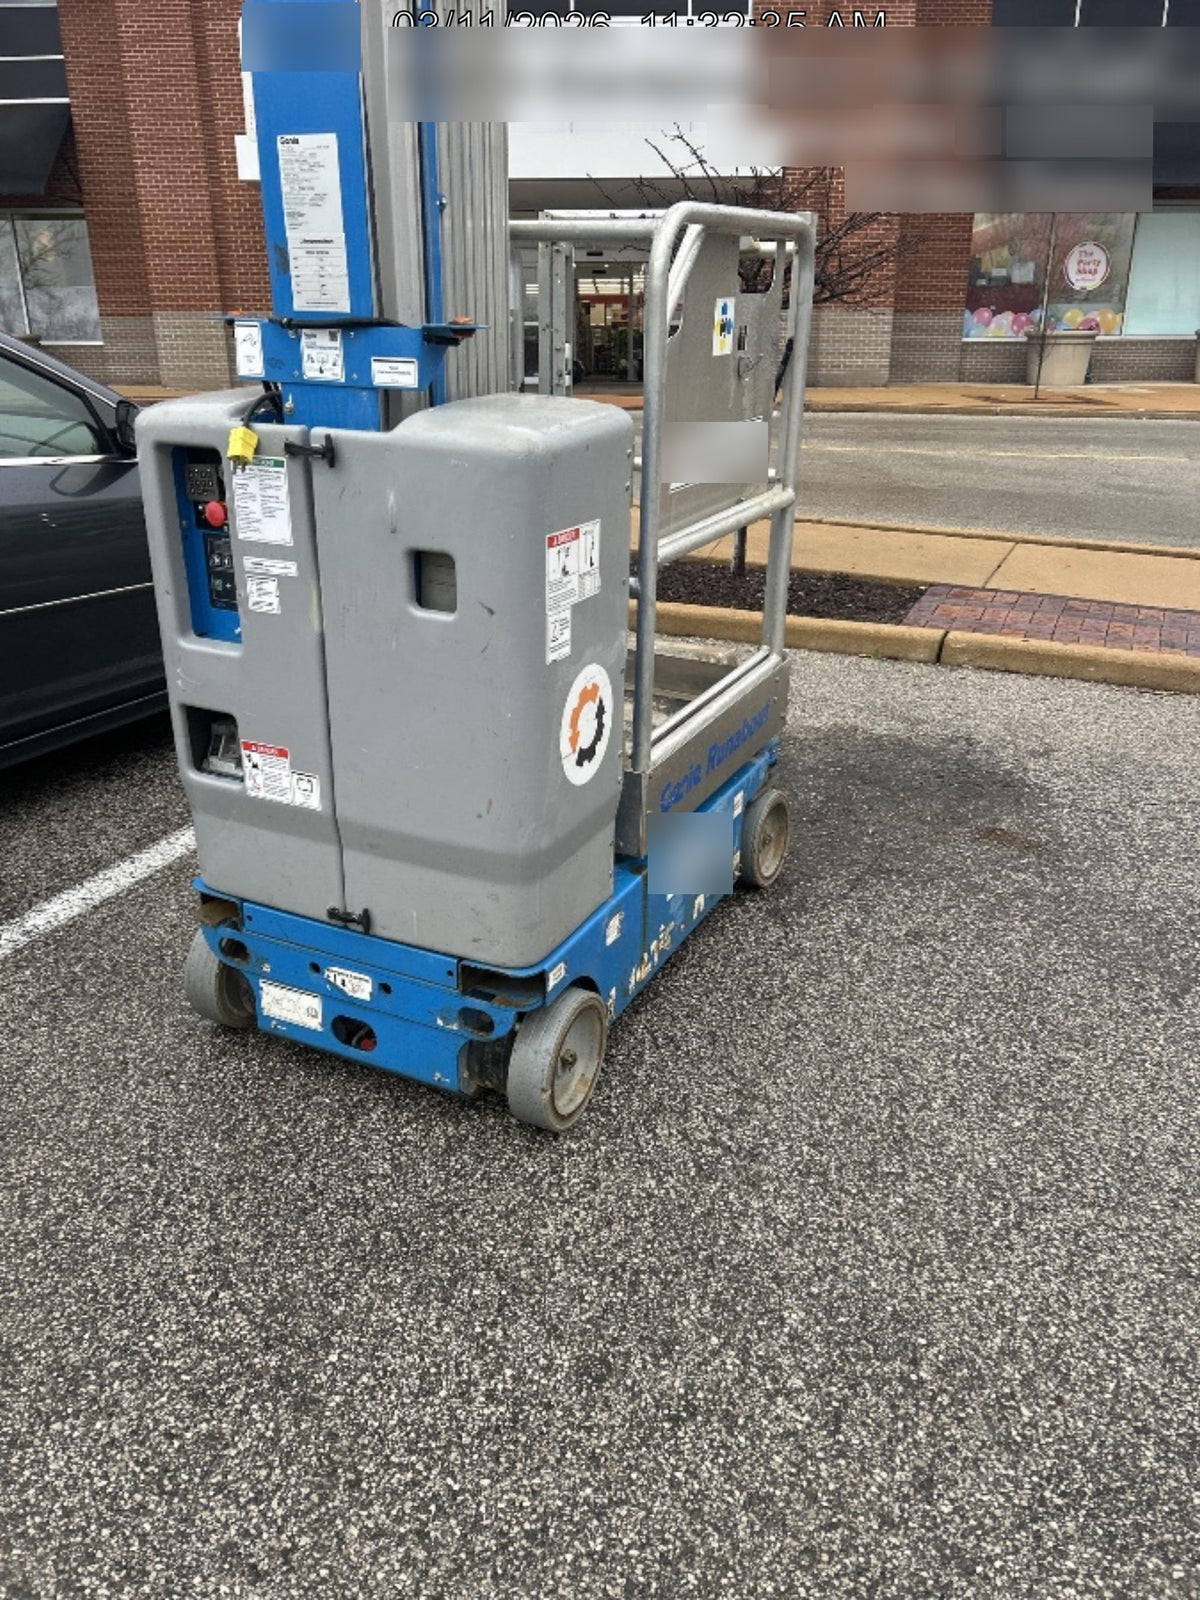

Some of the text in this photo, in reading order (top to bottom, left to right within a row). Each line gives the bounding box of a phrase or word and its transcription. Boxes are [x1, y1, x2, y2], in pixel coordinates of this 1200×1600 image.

[1079, 250, 1094, 258] The
[1077, 259, 1102, 268] Party
[1077, 267, 1099, 276] Shop
[659, 698, 773, 813] Genie Runabout
